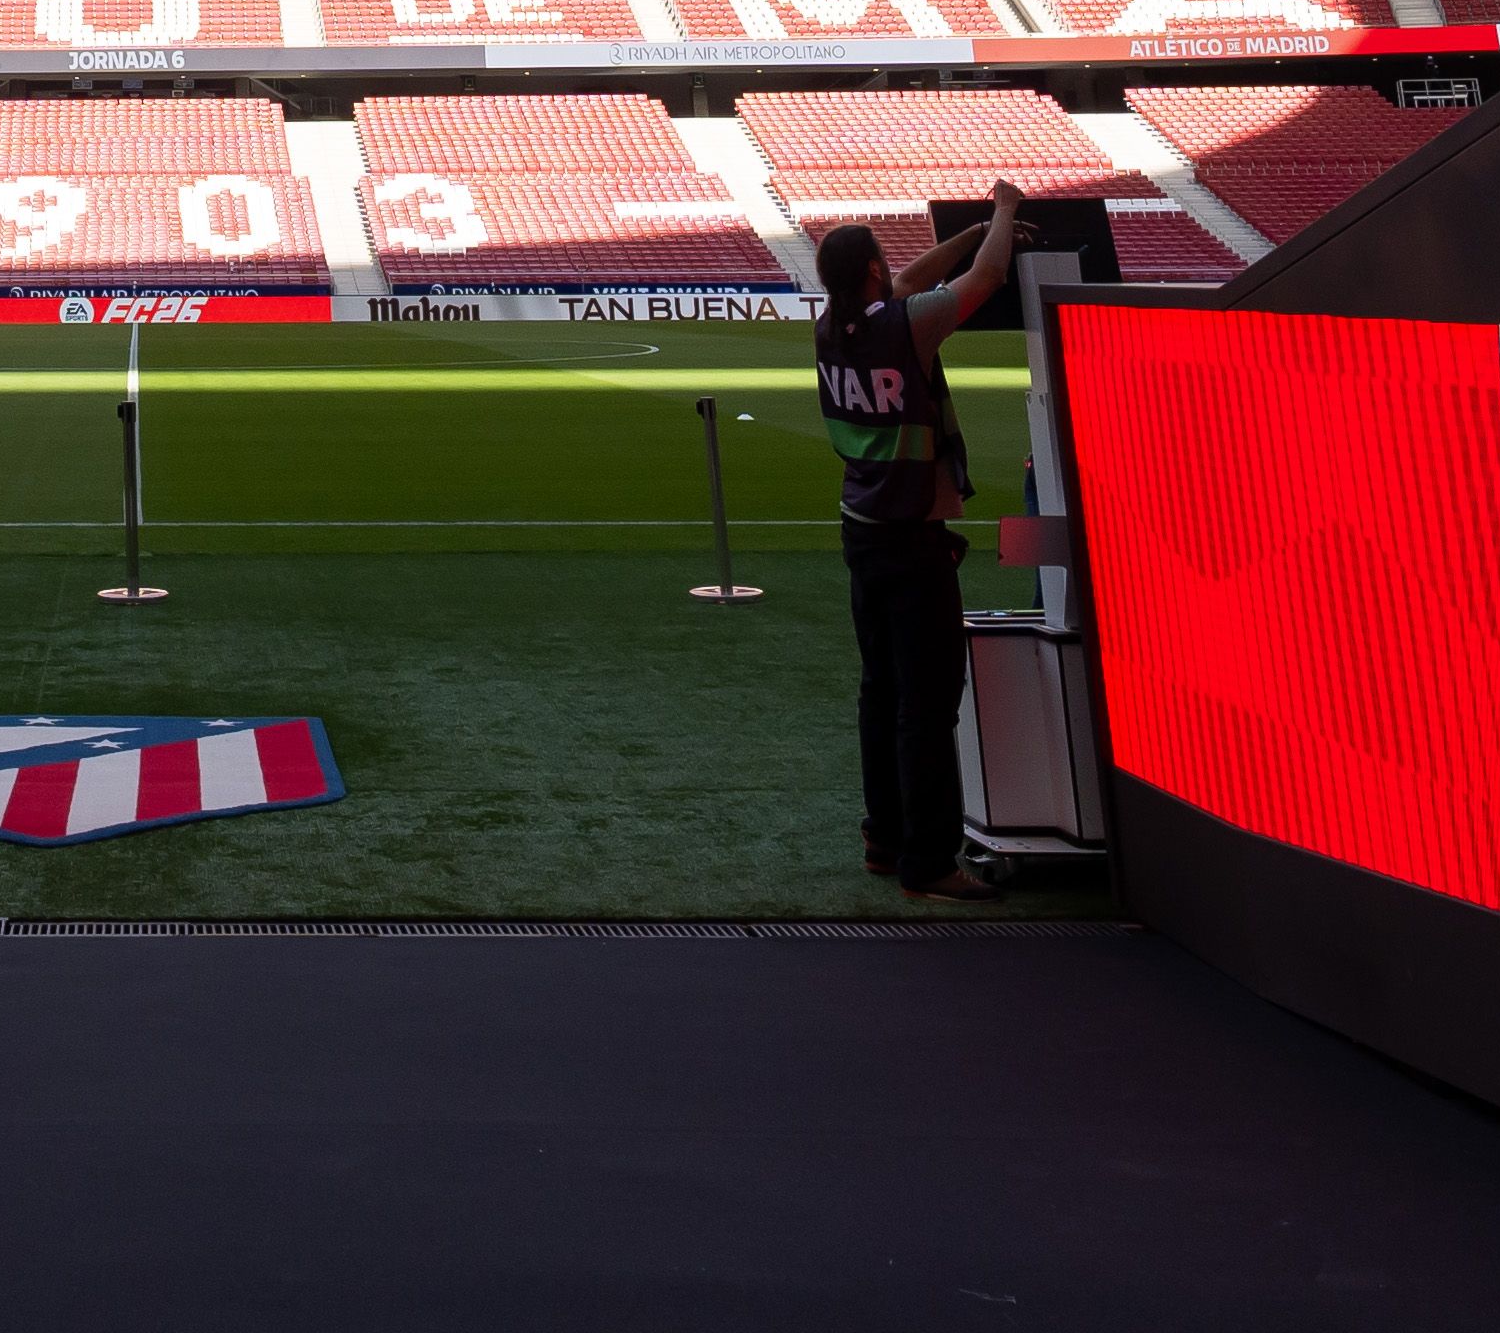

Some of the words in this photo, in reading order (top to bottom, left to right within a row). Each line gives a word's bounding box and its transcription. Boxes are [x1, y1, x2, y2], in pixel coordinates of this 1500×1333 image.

[628, 46, 687, 61] RIYADH
[691, 45, 719, 61] AIR
[723, 44, 846, 61] METROPOLITANO
[1129, 35, 1223, 57] ATLÉTICO
[1226, 42, 1241, 52] DE
[1245, 36, 1330, 55] MADRID
[68, 50, 169, 70] JORNADA
[171, 49, 186, 69] 6
[66, 302, 88, 315] EA
[366, 296, 481, 322] Mahou
[558, 296, 636, 321] TAN
[648, 296, 791, 321] BUENA.
[818, 361, 906, 414] VAR
